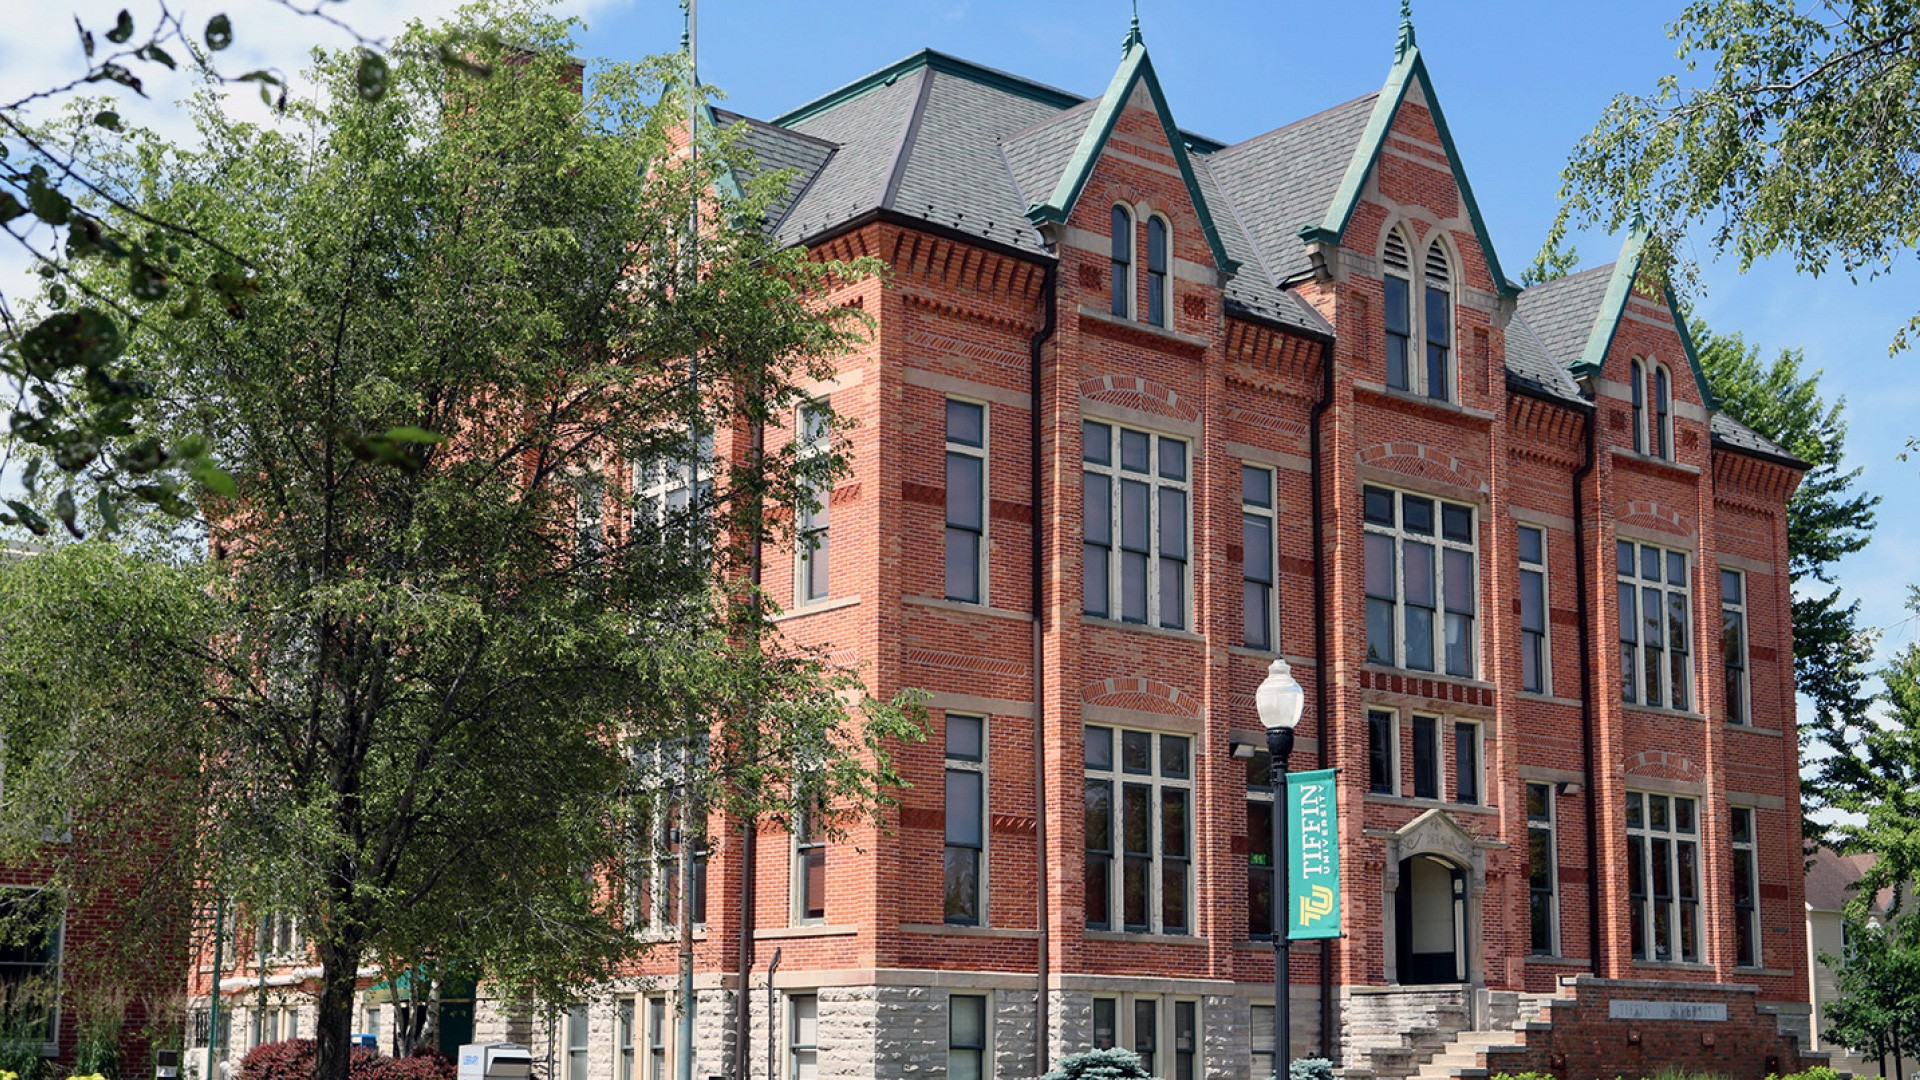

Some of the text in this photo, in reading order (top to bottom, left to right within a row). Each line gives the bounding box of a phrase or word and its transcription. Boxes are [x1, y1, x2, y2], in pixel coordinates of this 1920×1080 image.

[1300, 784, 1322, 879] TIFFIN
[1317, 785, 1331, 875] UNIVERSITY
[1299, 884, 1334, 926] TU
